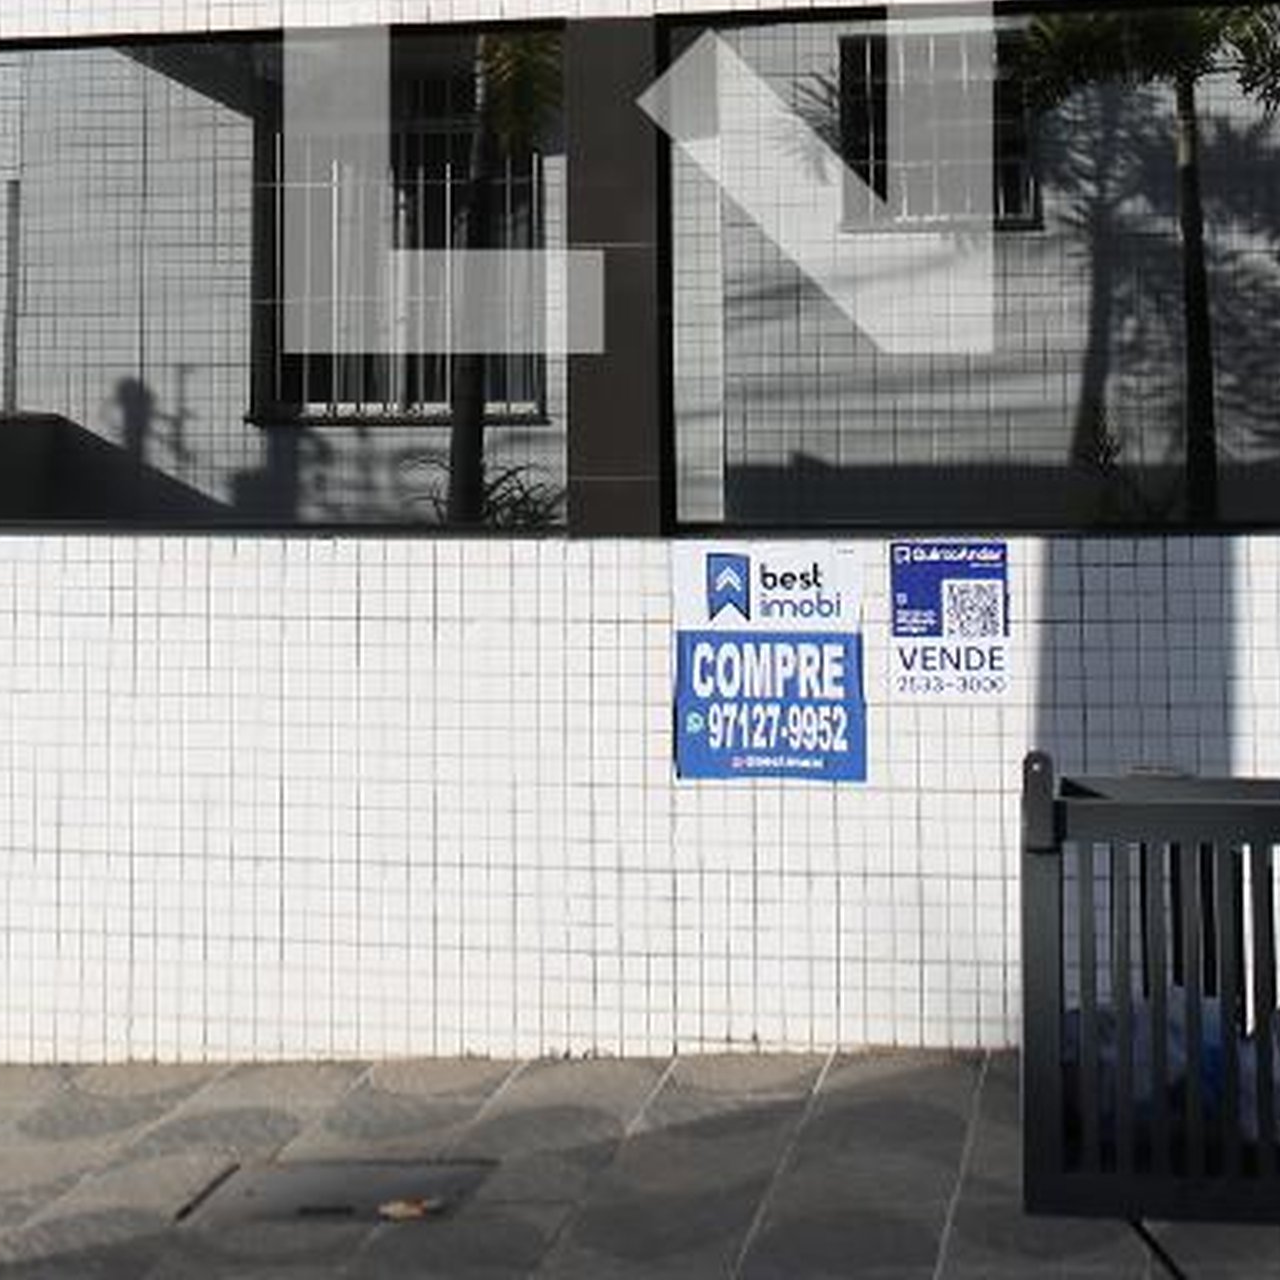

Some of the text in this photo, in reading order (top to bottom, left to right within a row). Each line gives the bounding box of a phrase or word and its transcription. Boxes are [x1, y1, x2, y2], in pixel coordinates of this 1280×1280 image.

[760, 562, 821, 591] best
[759, 592, 841, 617] imobi
[693, 642, 845, 698] COMPRE
[898, 646, 1005, 671] VENDE
[708, 702, 848, 751] 97127-9952
